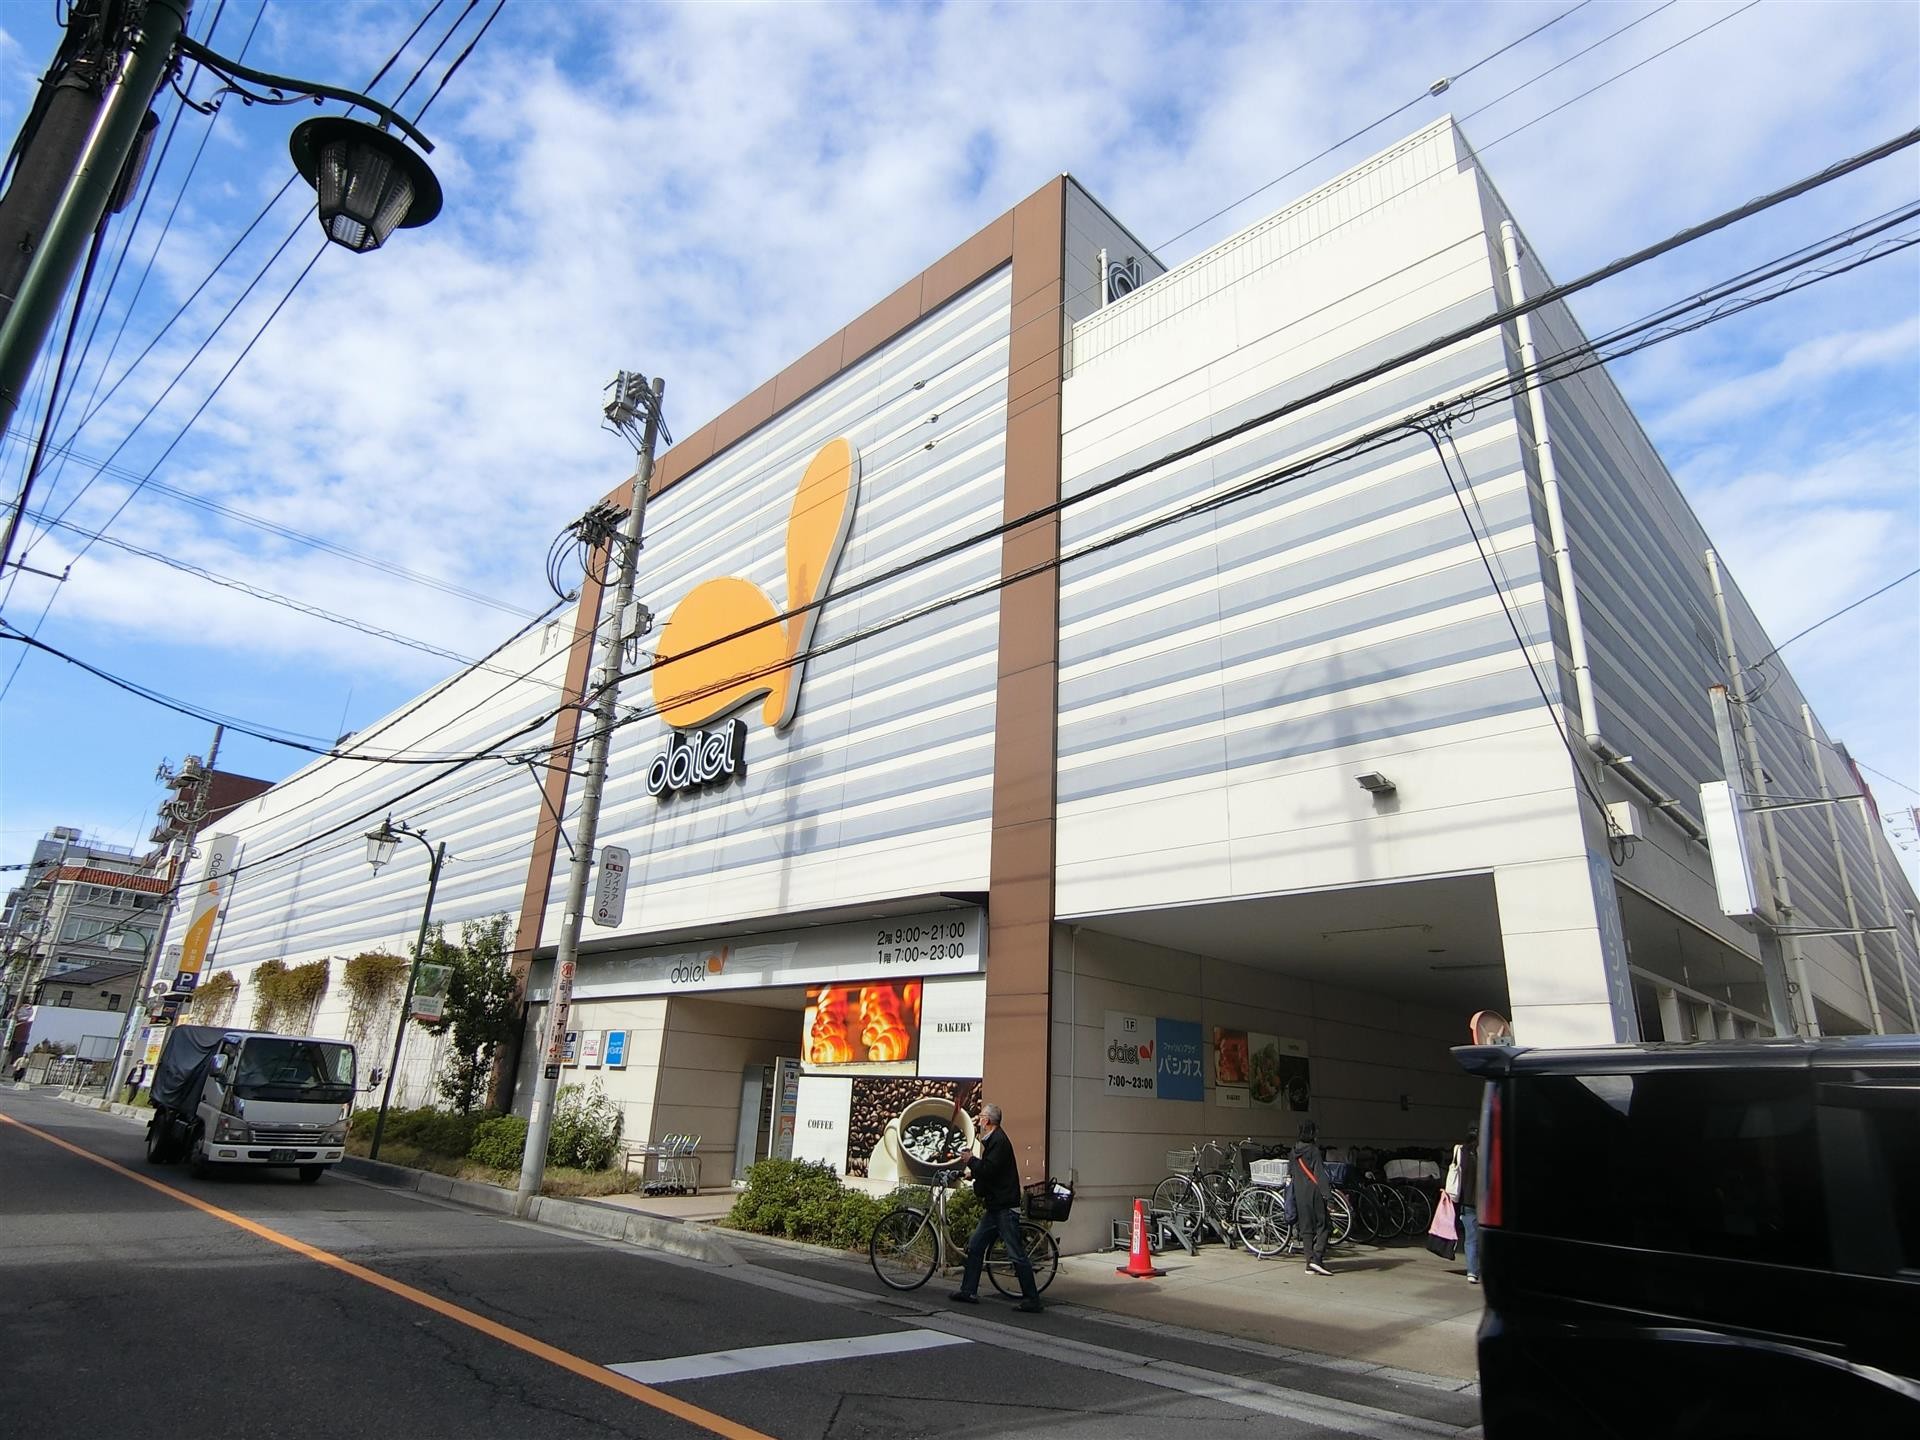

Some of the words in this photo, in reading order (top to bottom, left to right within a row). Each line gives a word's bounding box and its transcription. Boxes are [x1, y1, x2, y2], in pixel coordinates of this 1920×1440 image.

[646, 718, 738, 797] daiei
[602, 871, 613, 907] クリニック
[611, 872, 622, 901] アイケア
[877, 931, 893, 945] 2階
[878, 950, 892, 964] 1階
[181, 974, 194, 985] P
[671, 960, 706, 983] daiei
[937, 1022, 972, 1032] BAKERY
[1125, 1020, 1136, 1030] 1F
[1108, 1039, 1139, 1065] daiei
[1158, 1055, 1202, 1077] パシオス
[808, 1119, 833, 1129] COFFEE
